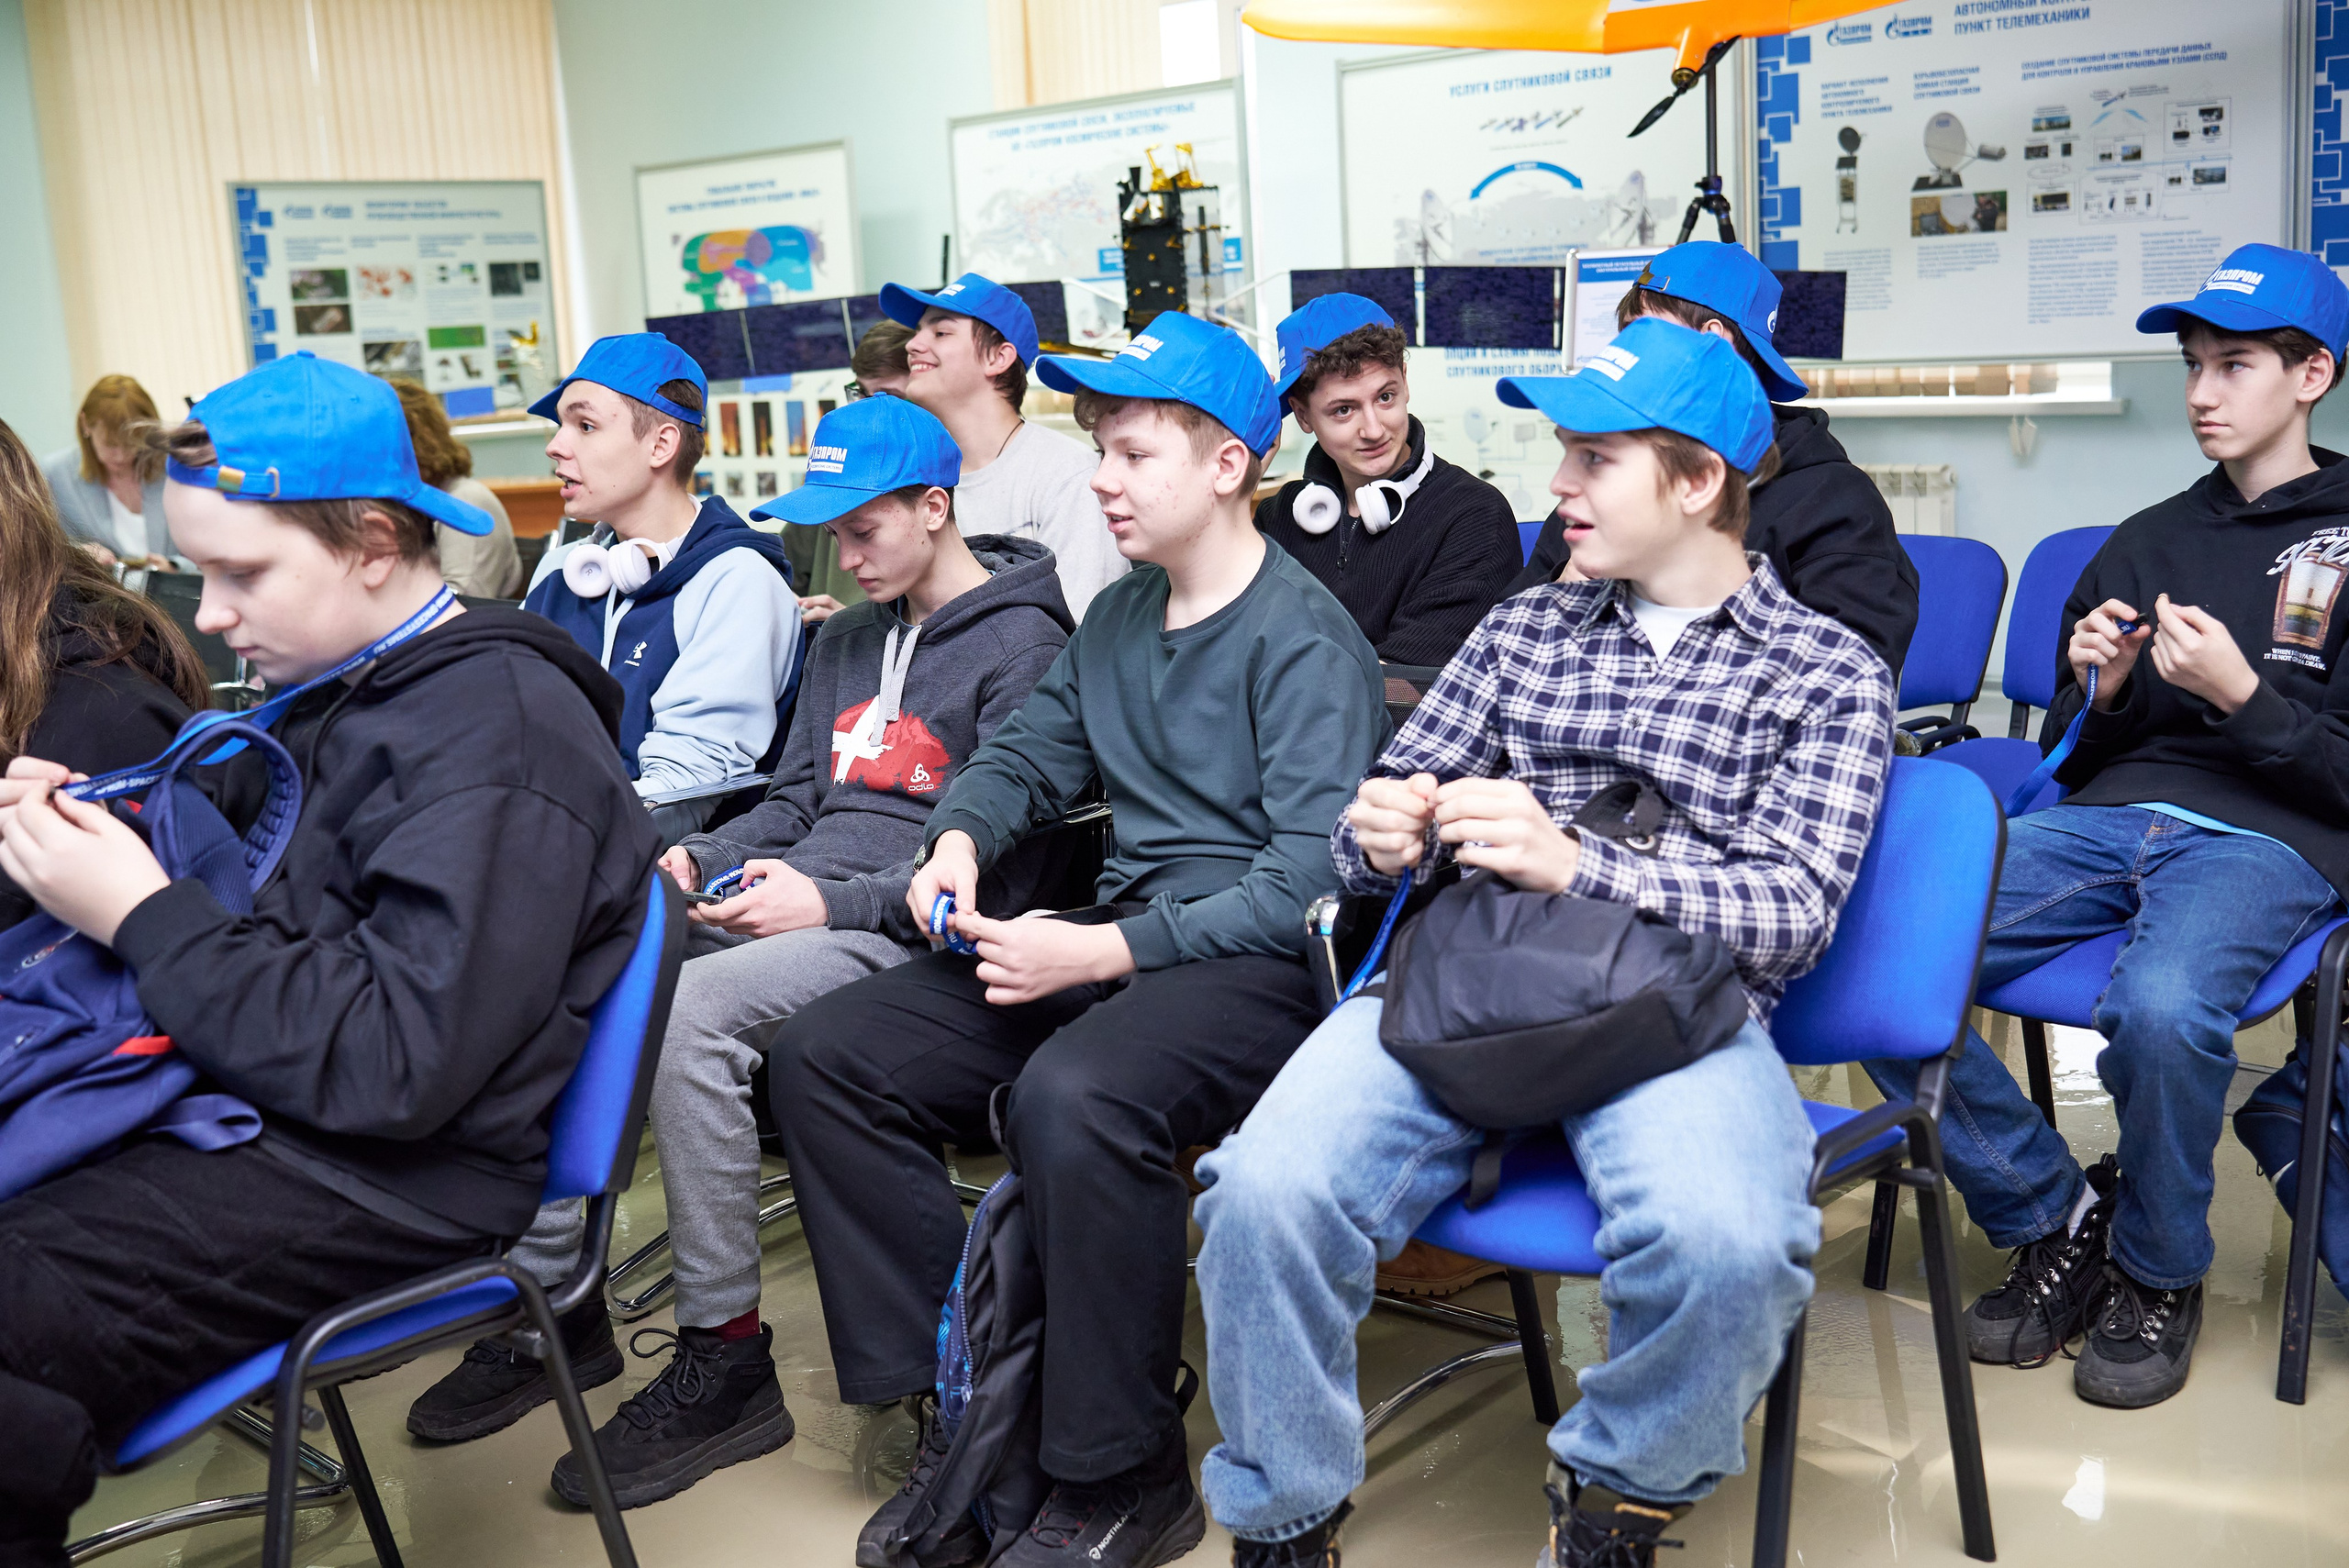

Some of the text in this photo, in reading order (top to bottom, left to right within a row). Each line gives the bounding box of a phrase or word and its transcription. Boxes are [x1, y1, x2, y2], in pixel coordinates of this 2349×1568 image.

[1954, 19, 1992, 35] ПУНКТ
[1997, 6, 2090, 30] ТЕЛЕМЕХАНИКИ
[1493, 69, 1571, 93] СПУТНИКОВОЙ
[1575, 65, 1612, 83] СВЯЗИ
[2212, 269, 2265, 285] ГАЗПРОМ
[907, 783, 935, 792] odlo
[1098, 1514, 1130, 1551] NORTHLA
